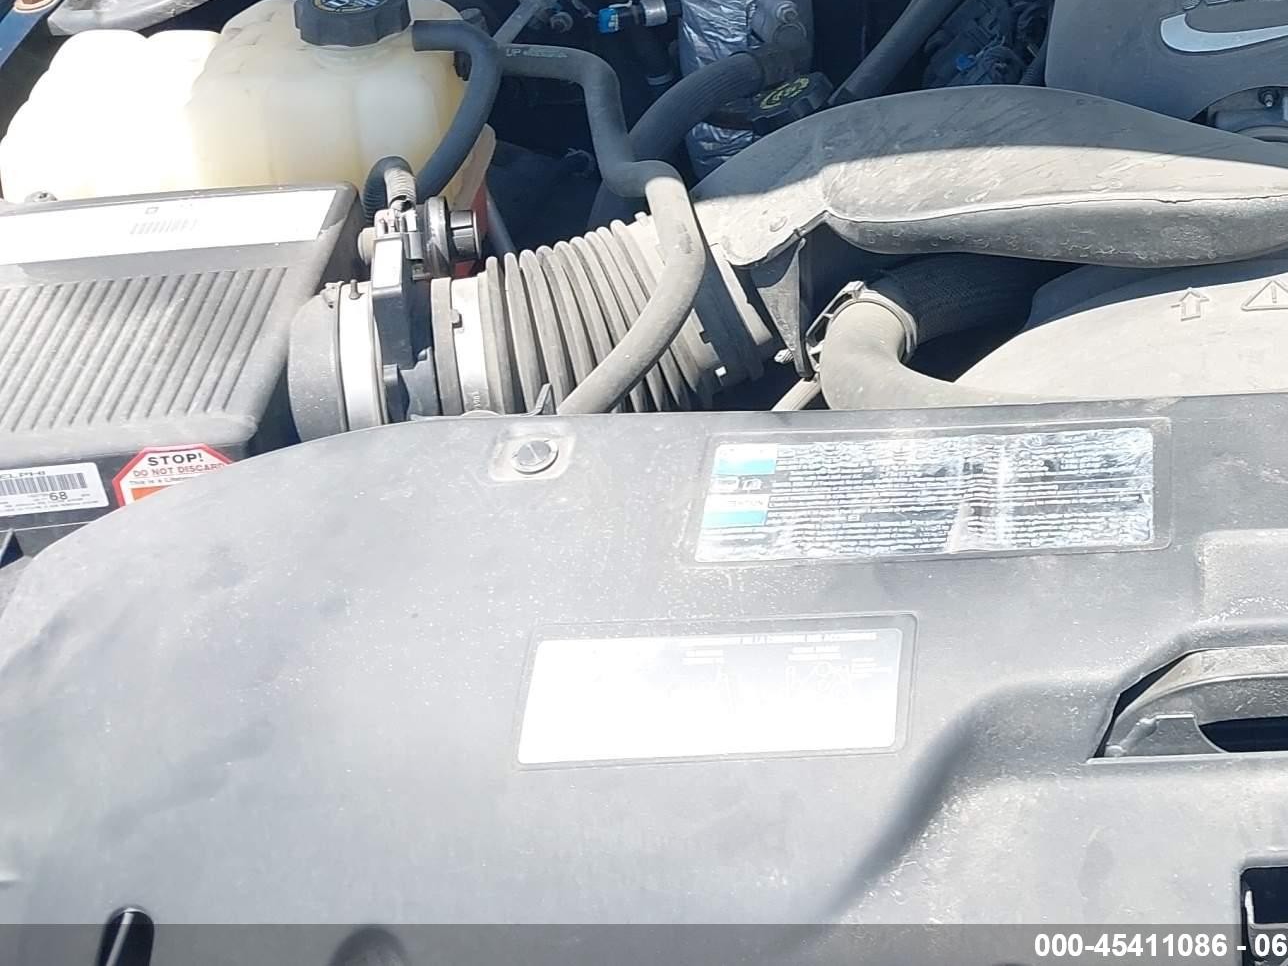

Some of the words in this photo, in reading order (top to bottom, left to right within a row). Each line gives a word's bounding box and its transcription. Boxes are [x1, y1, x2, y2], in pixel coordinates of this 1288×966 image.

[147, 452, 205, 467] STOP!
[0, 470, 46, 479] ELPHI
[132, 469, 149, 478] DO
[152, 466, 174, 476] NOT
[49, 491, 68, 502] 68
